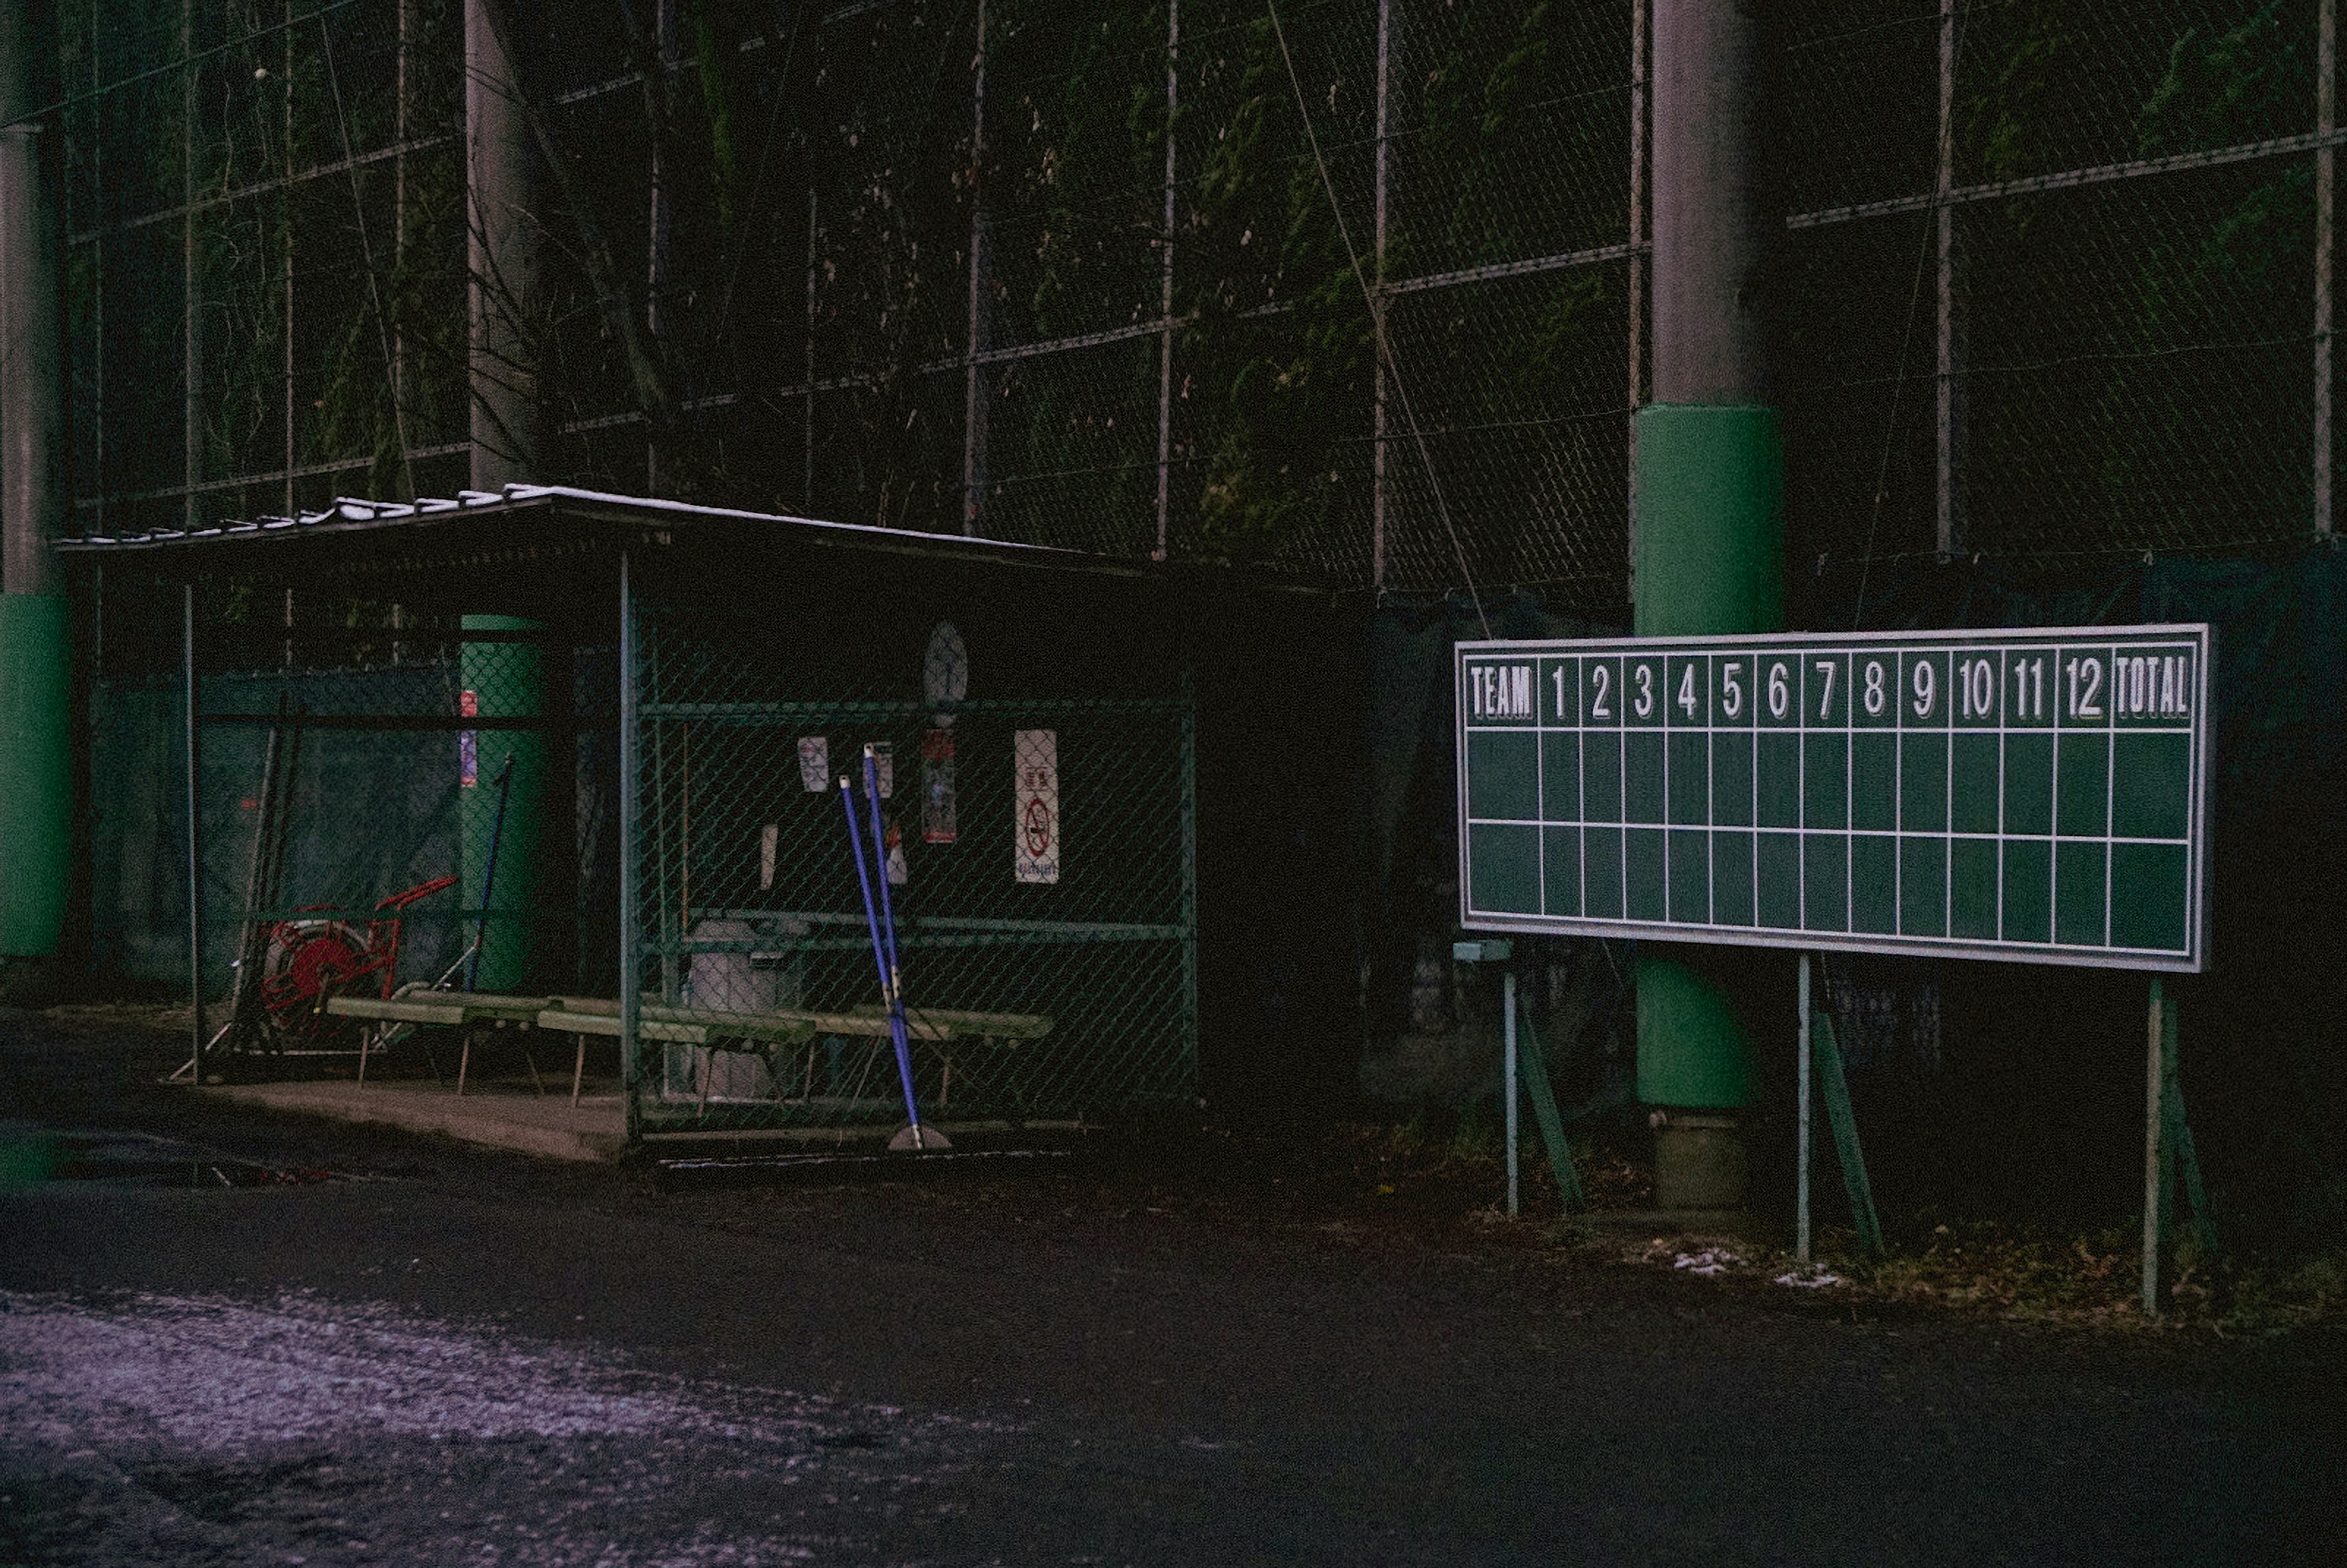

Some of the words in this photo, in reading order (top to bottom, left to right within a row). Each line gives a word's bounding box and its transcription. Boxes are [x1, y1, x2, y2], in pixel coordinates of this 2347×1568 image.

[1471, 665, 1531, 719] TEAM
[1553, 665, 1565, 718] 1
[1592, 665, 1611, 718] 2
[1635, 665, 1653, 718] 3
[1678, 663, 1696, 719] 4
[1723, 662, 1742, 720] 5
[1769, 662, 1789, 720] 6
[1816, 661, 1836, 719] 7
[1864, 661, 1884, 717] 8
[1914, 660, 1935, 719] 9
[1960, 659, 1993, 719] 10
[2015, 658, 2043, 719] 11
[2067, 657, 2103, 719] 12
[2116, 656, 2190, 719] TOTAL
